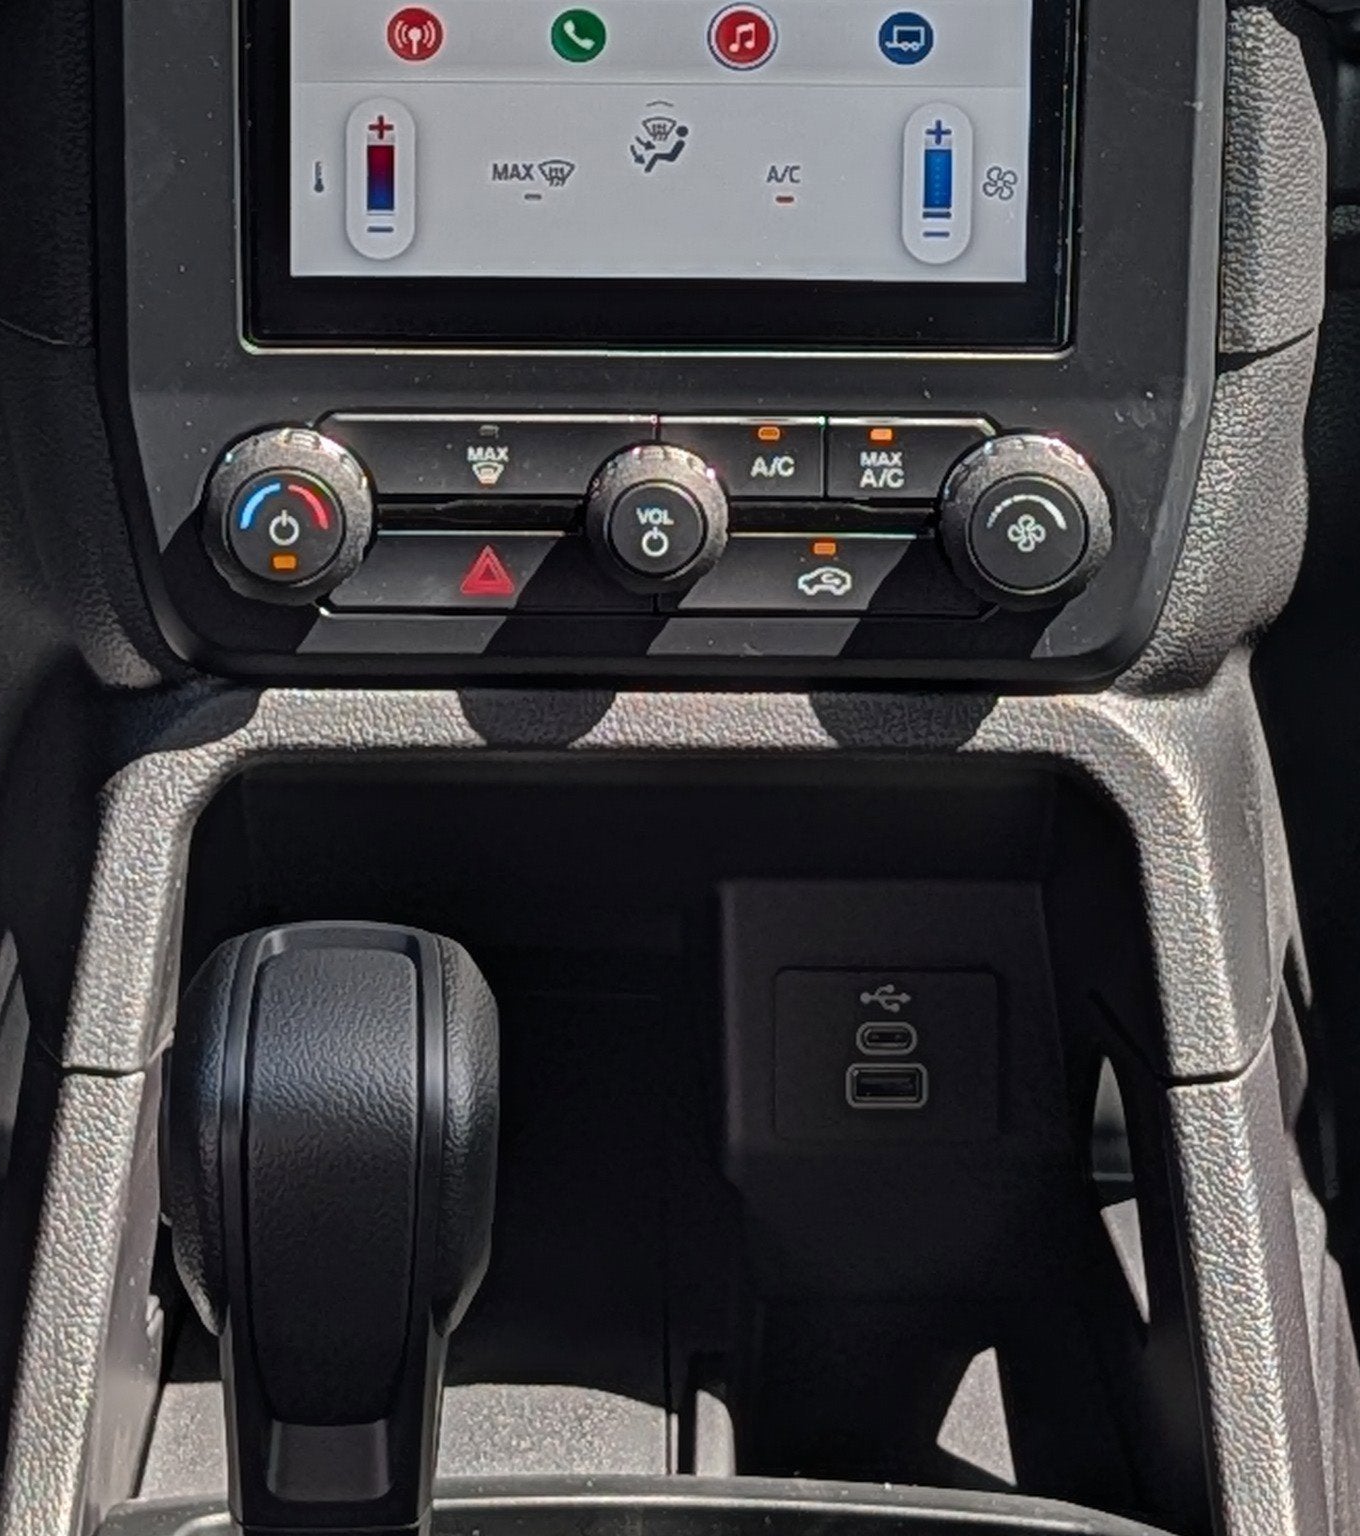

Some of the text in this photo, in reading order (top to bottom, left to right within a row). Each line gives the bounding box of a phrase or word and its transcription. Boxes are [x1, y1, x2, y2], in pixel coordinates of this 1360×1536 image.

[491, 163, 535, 181] MAX
[766, 165, 801, 184] A/C
[467, 446, 509, 464] MAX
[860, 451, 903, 467] MAX
[750, 455, 795, 478] A/C
[860, 467, 905, 489] A/C
[636, 507, 675, 526] VOL
